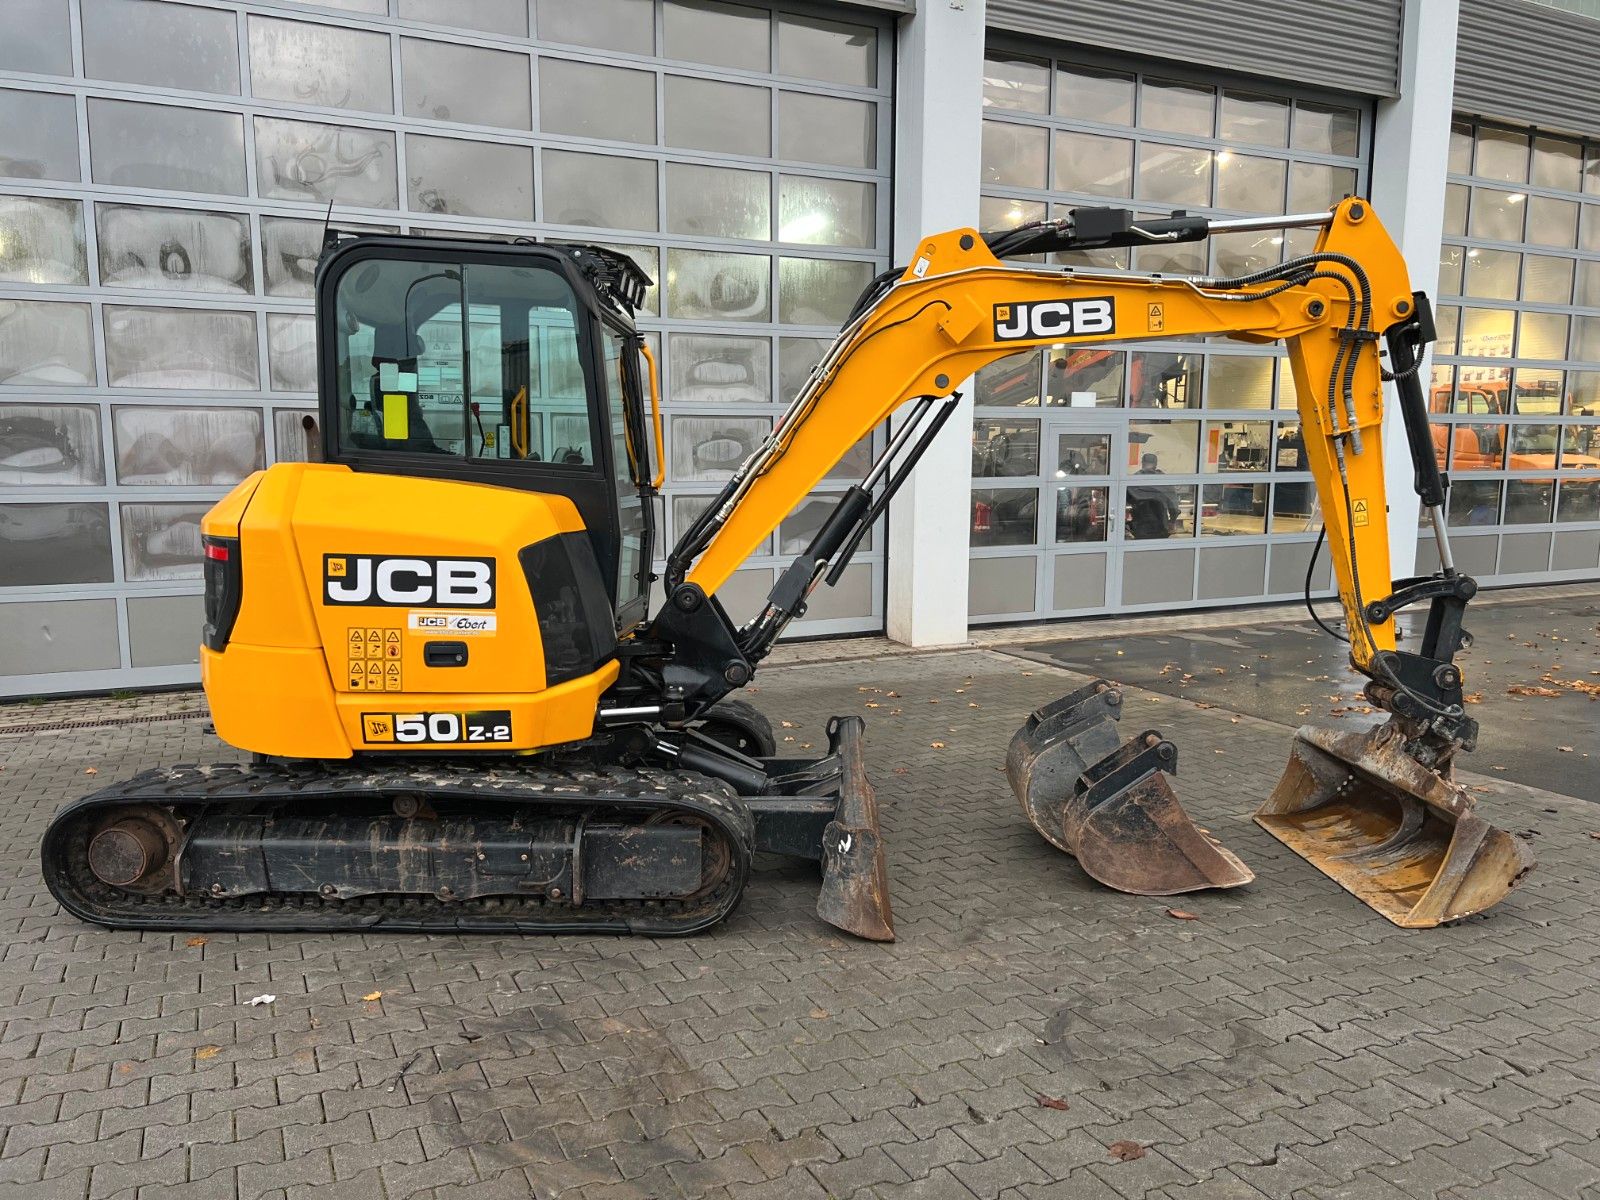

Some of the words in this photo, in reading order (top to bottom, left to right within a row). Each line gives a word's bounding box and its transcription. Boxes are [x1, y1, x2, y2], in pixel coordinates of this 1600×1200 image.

[996, 299, 1113, 338] JCB
[327, 558, 493, 605] JCB
[419, 617, 446, 626] JCB
[456, 618, 488, 630] Ebert
[371, 721, 389, 735] JCB
[395, 713, 460, 742] 50
[468, 725, 510, 741] Z-2
